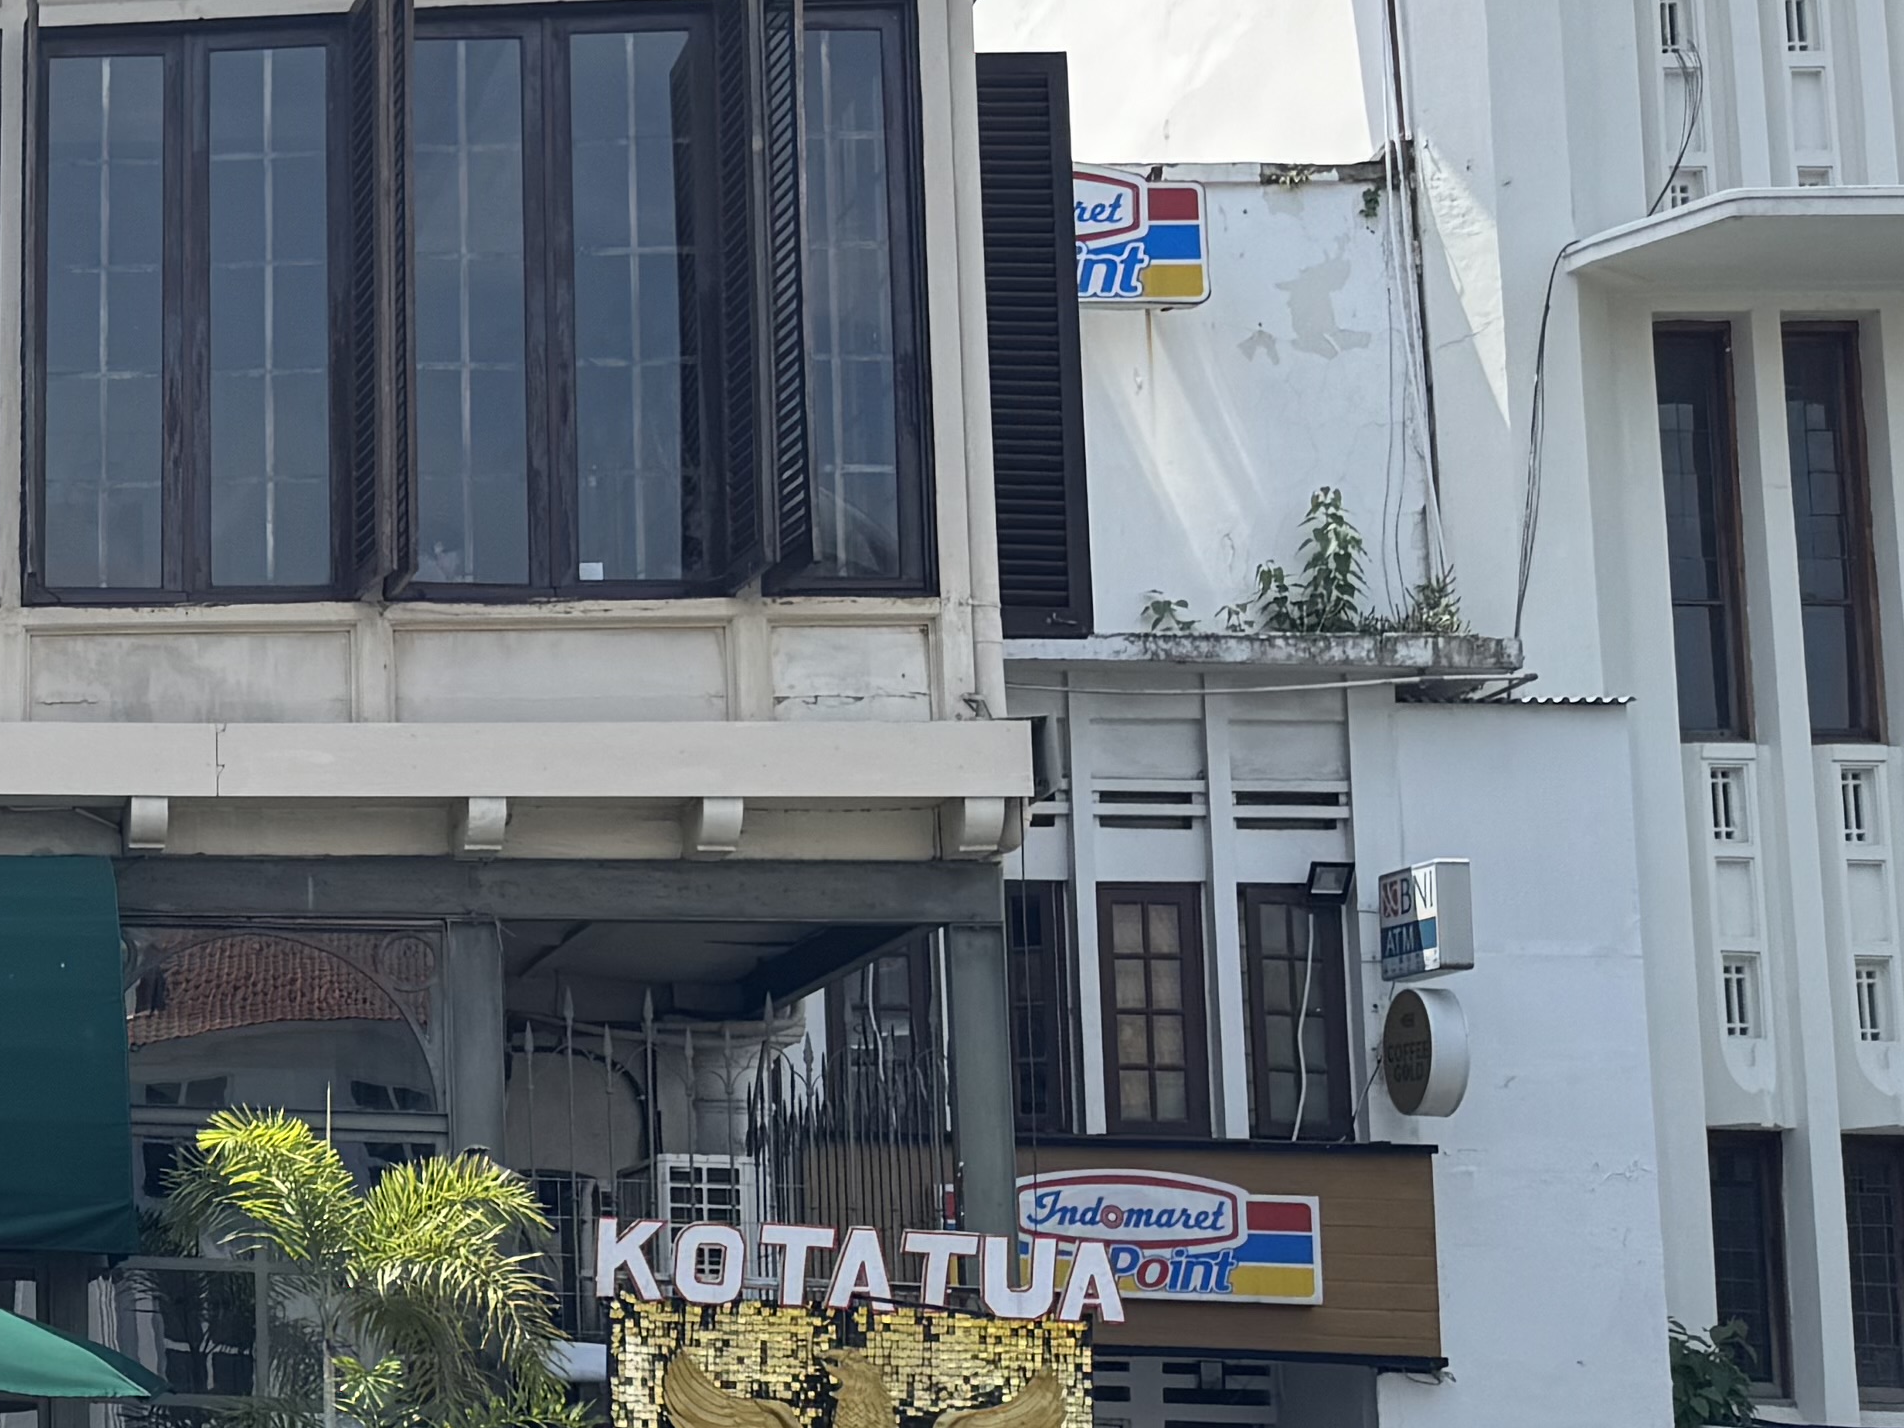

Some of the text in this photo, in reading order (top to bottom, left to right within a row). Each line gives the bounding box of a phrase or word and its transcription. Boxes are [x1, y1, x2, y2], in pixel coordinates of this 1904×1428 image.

[1400, 869, 1434, 916] BNI
[1385, 923, 1415, 957] ATM
[1387, 1040, 1431, 1063] COFFEE
[1393, 1061, 1424, 1083] GOLD
[1026, 1189, 1226, 1232] Indomaret
[1110, 1245, 1238, 1293] Point
